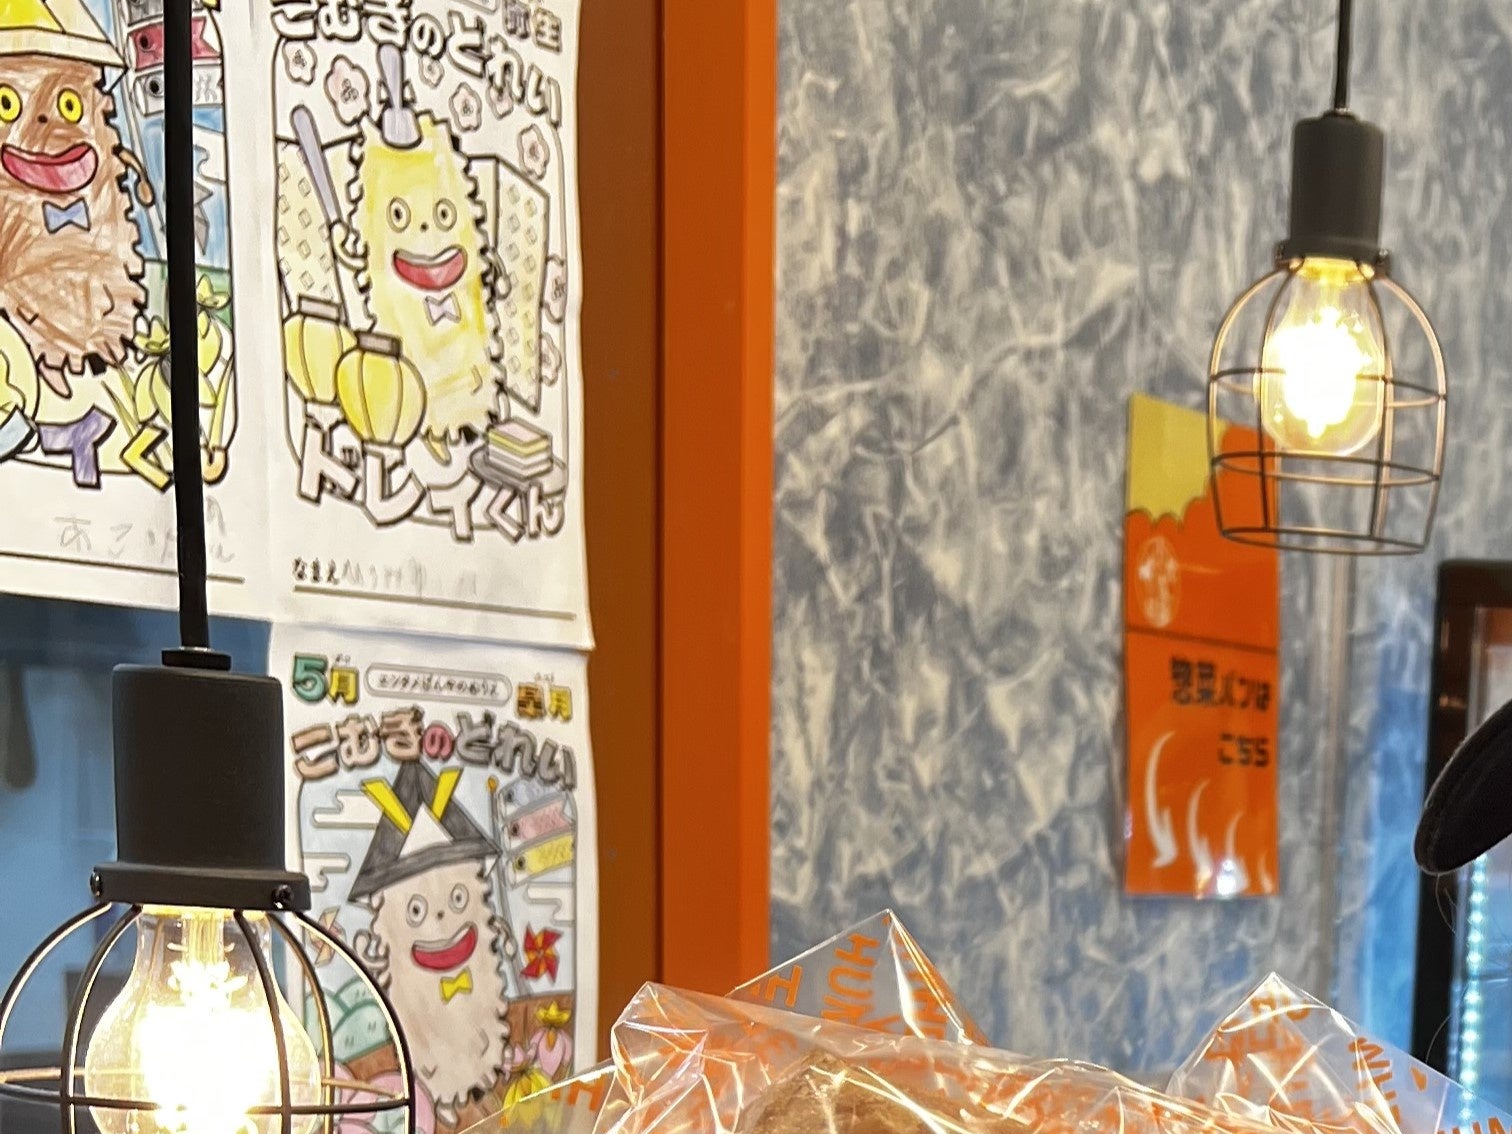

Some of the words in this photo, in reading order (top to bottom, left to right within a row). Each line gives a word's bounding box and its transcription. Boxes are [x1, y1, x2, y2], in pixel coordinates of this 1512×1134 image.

[291, 652, 360, 706] 5月
[291, 704, 578, 791] こむぎのどれい
